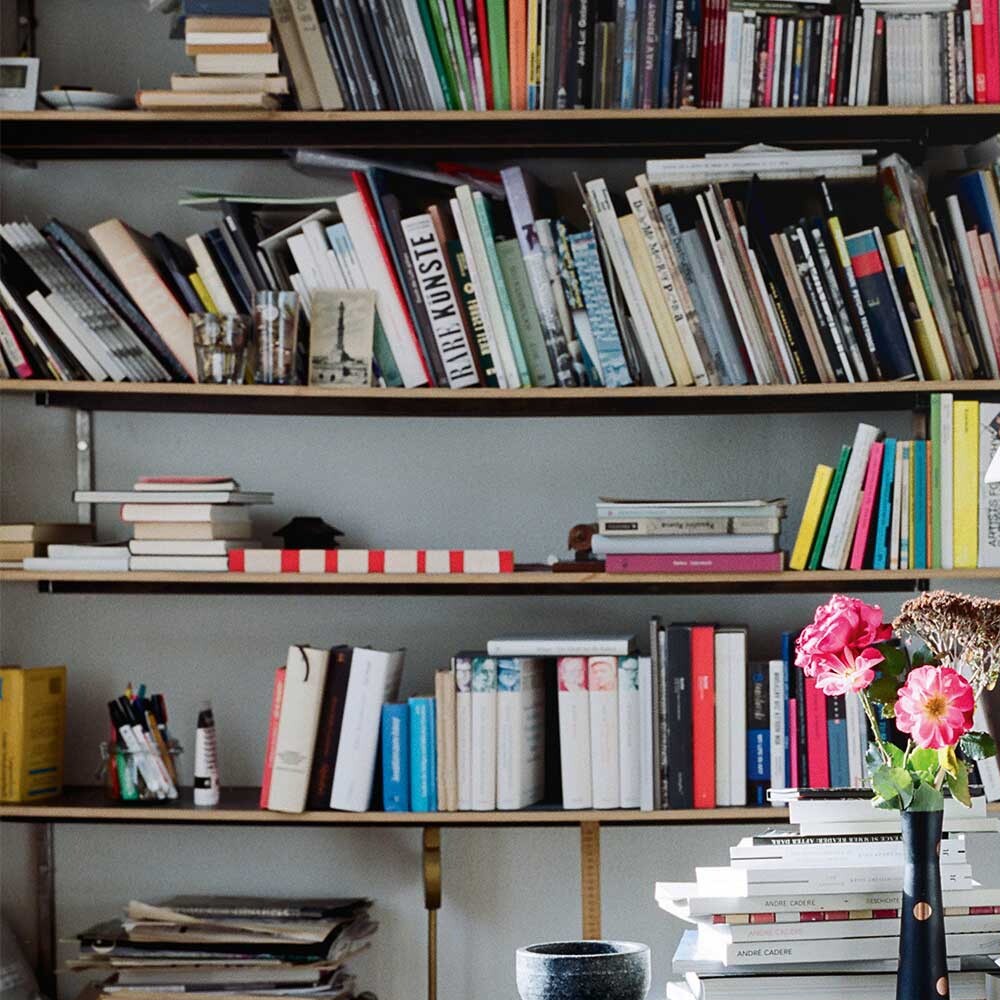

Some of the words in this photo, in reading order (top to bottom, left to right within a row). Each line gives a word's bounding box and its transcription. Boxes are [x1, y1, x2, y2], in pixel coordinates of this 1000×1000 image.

[440, 324, 474, 379] RARE
[988, 500, 997, 547] ARTISTS
[764, 948, 792, 956] CADERE
